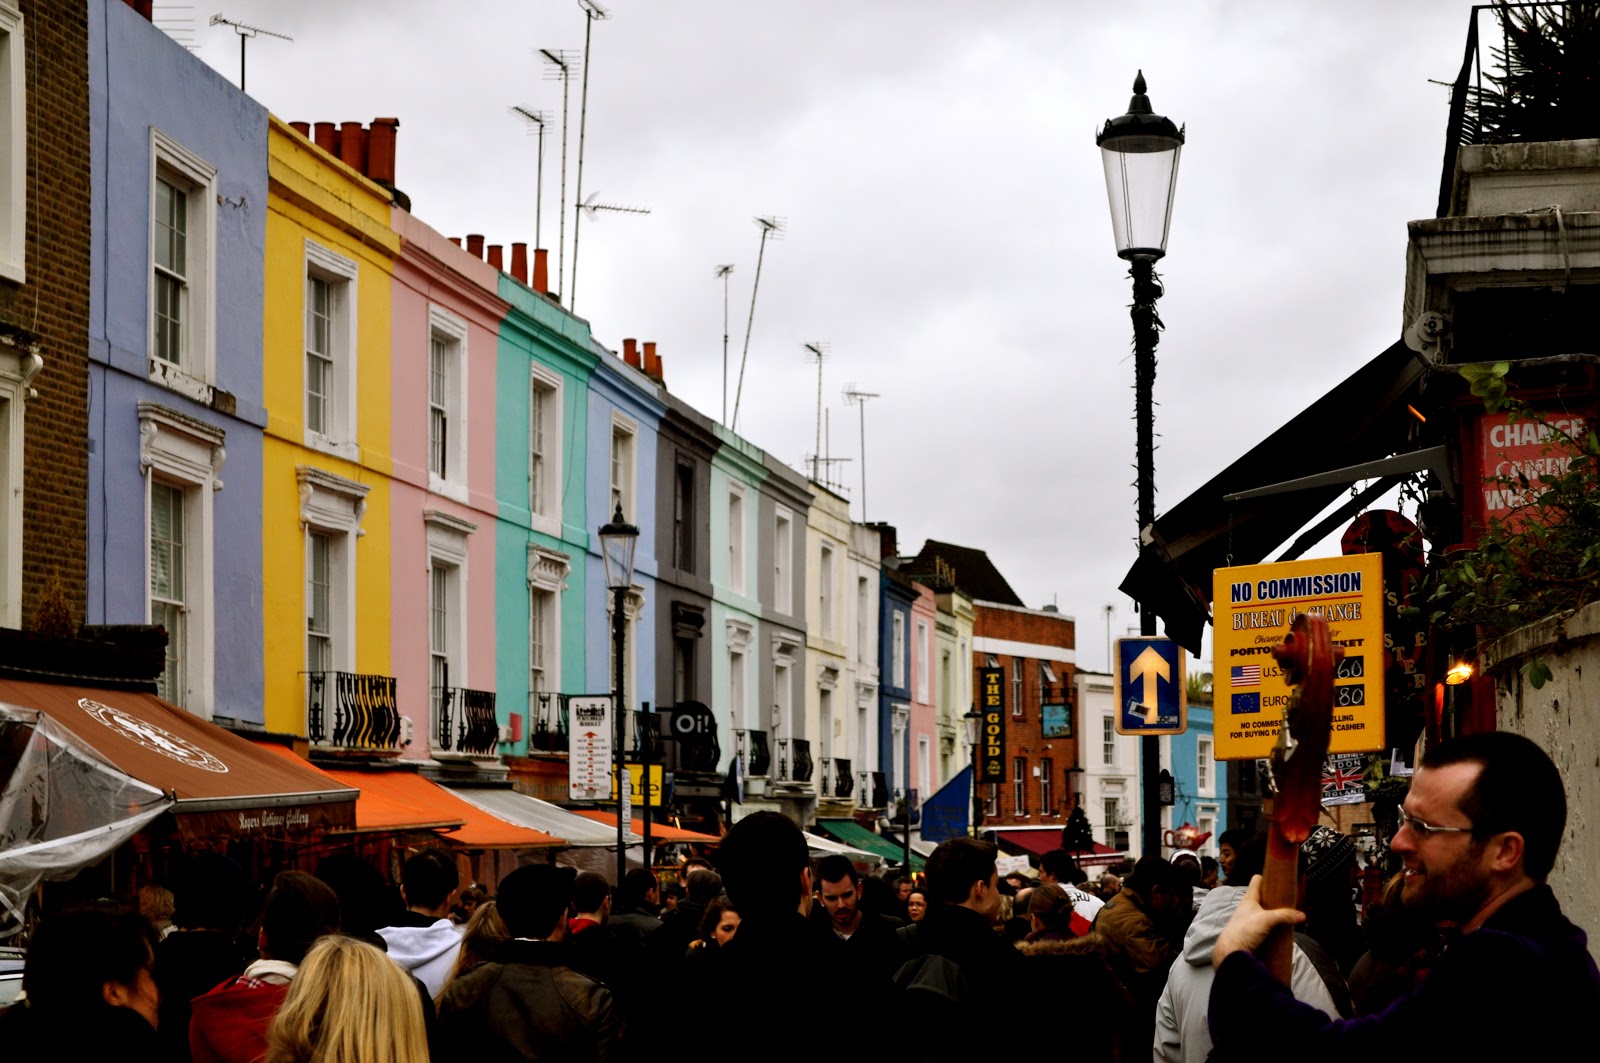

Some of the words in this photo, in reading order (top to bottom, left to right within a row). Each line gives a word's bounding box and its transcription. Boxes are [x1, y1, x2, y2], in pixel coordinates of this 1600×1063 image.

[1231, 582, 1252, 603] NO
[1257, 571, 1362, 600] COMMISSION
[1232, 608, 1285, 630] BUREAU
[1288, 606, 1303, 625] d
[1254, 634, 1284, 644] Change
[1230, 646, 1272, 657] PORTO
[986, 673, 1000, 706] THE
[1262, 695, 1289, 707] EURO
[1339, 687, 1363, 706] 80
[676, 714, 709, 733] Oi!
[1245, 730, 1270, 738] BUYING
[1336, 722, 1365, 732] CASHIER
[1252, 719, 1283, 729] COMMISS
[1330, 714, 1354, 723] ELLING
[987, 713, 1001, 757] GOLD
